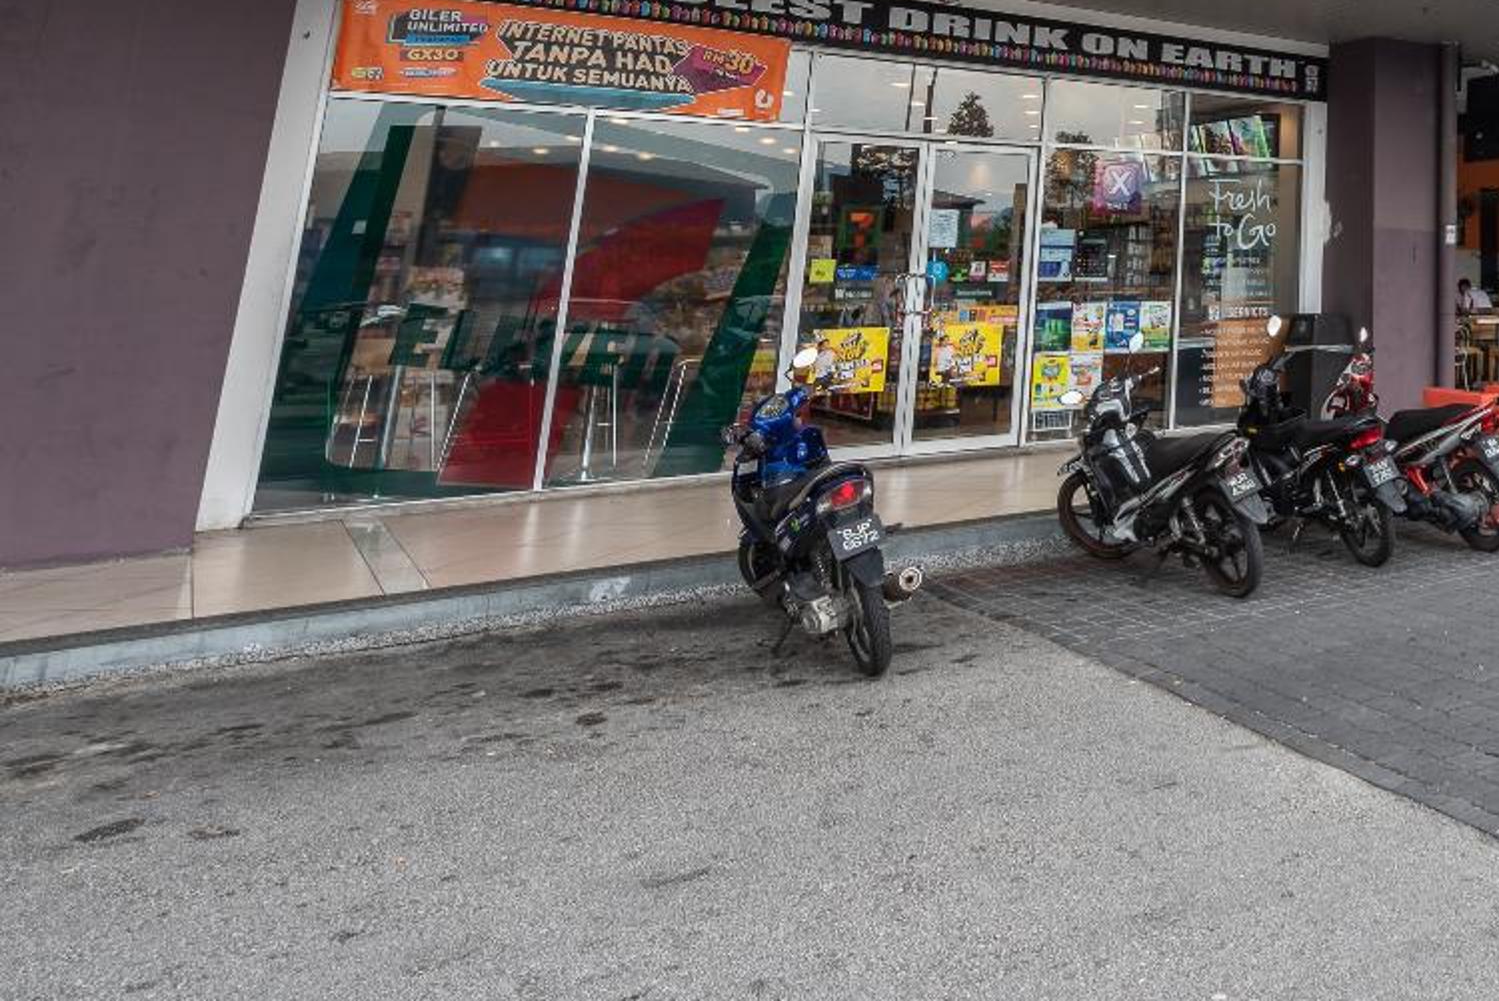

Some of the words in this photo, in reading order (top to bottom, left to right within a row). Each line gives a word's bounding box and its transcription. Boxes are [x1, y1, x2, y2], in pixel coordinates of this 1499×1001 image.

[406, 19, 490, 35] UNLIMITED
[500, 18, 606, 46] INTERNET
[608, 31, 692, 56] PANTAS
[887, 5, 1071, 52] DRINK
[1080, 29, 1149, 62] ON
[1160, 41, 1298, 80] EARTH
[486, 59, 570, 82] UNTUK
[511, 40, 607, 68] TANPA
[615, 48, 673, 75] HAD
[1208, 178, 1272, 214] Fresh
[1237, 212, 1277, 250] Go
